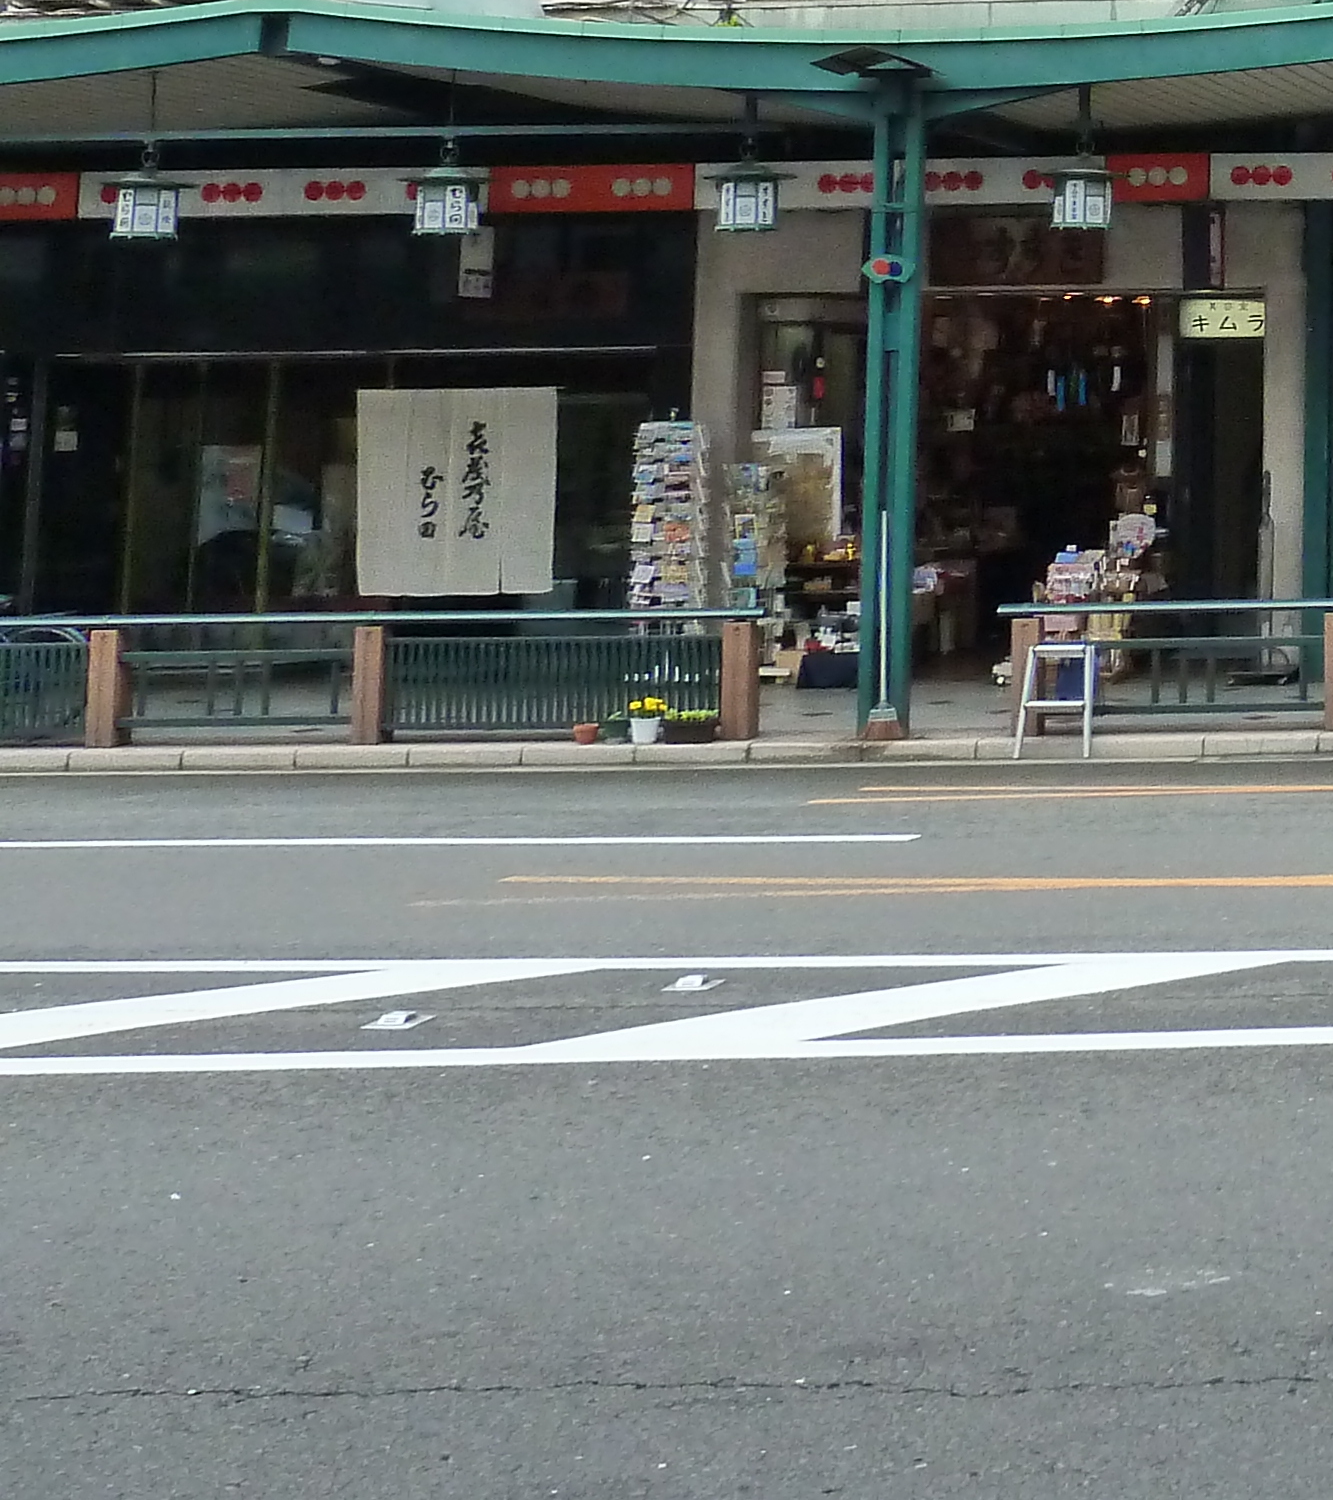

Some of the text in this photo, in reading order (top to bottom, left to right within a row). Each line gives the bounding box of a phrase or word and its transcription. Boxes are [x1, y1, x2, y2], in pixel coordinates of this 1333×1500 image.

[1192, 315, 1264, 333] キムラ
[418, 465, 445, 539] むら田
